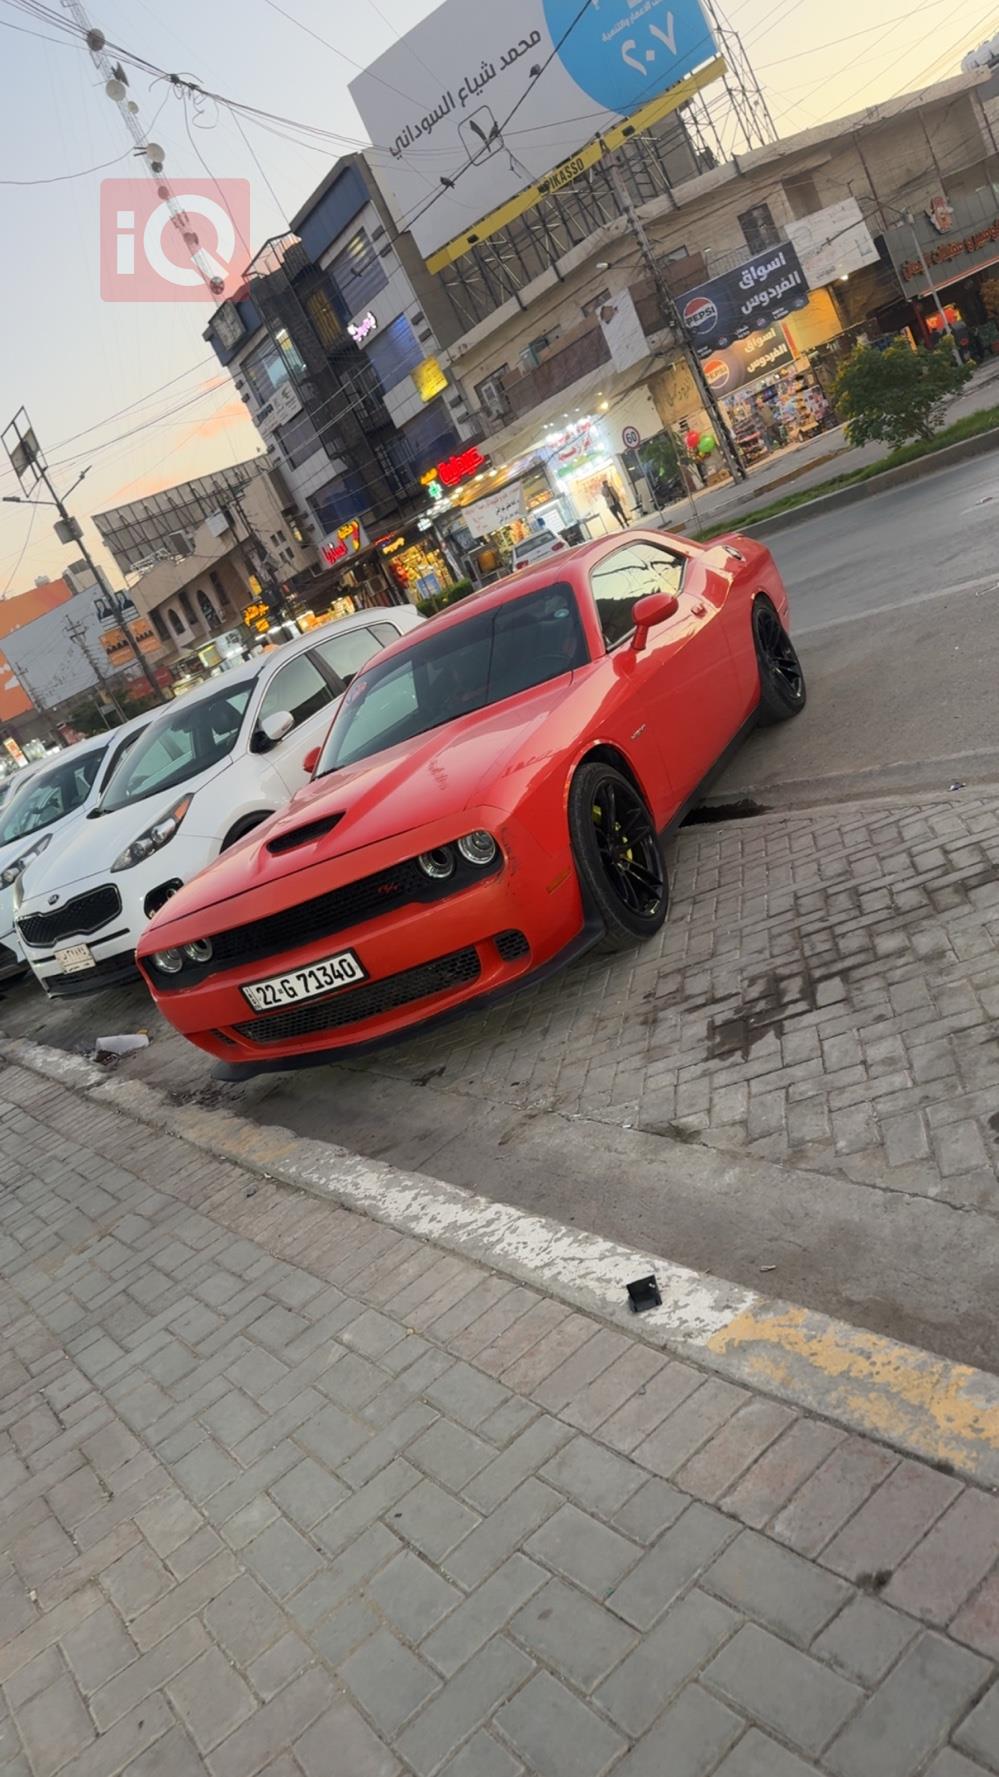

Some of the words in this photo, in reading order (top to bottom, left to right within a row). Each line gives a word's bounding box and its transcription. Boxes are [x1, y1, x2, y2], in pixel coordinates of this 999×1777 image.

[500, 30, 541, 71] محمد
[621, 10, 677, 77] ٢٠٧
[457, 60, 497, 108] شياع
[389, 91, 456, 160] السوداني
[739, 252, 787, 289] اسواق
[741, 270, 801, 315] الفردوس
[686, 305, 715, 328] PEPSI
[744, 327, 776, 353] اسواق
[747, 343, 788, 373] الفردوس
[626, 431, 637, 444] 60
[296, 959, 356, 993] 71340
